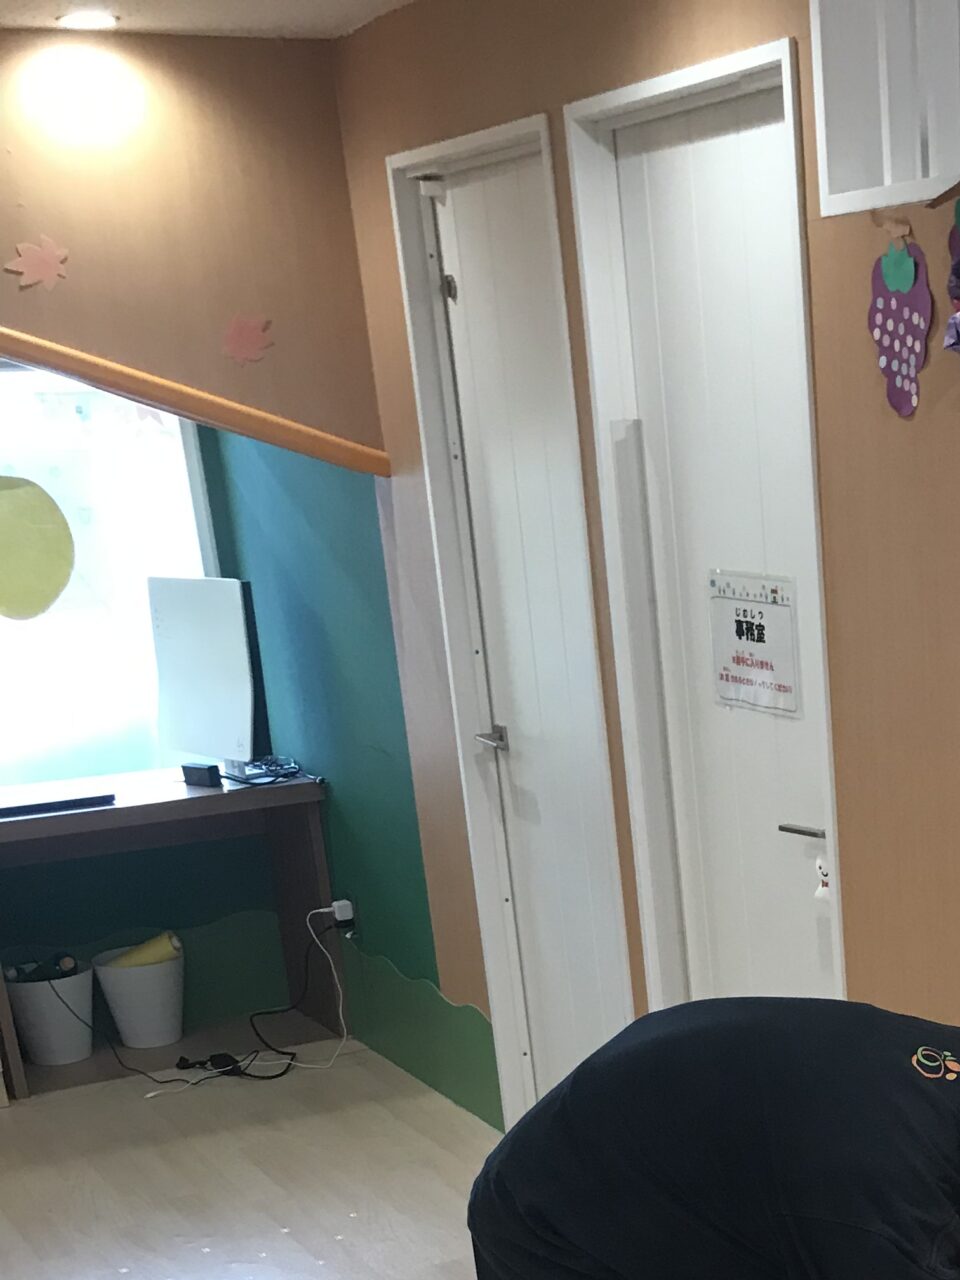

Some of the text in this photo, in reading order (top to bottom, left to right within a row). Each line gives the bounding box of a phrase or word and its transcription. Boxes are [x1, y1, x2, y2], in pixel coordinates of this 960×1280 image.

[735, 607, 763, 620] じむしつ
[735, 619, 766, 643] 事務室
